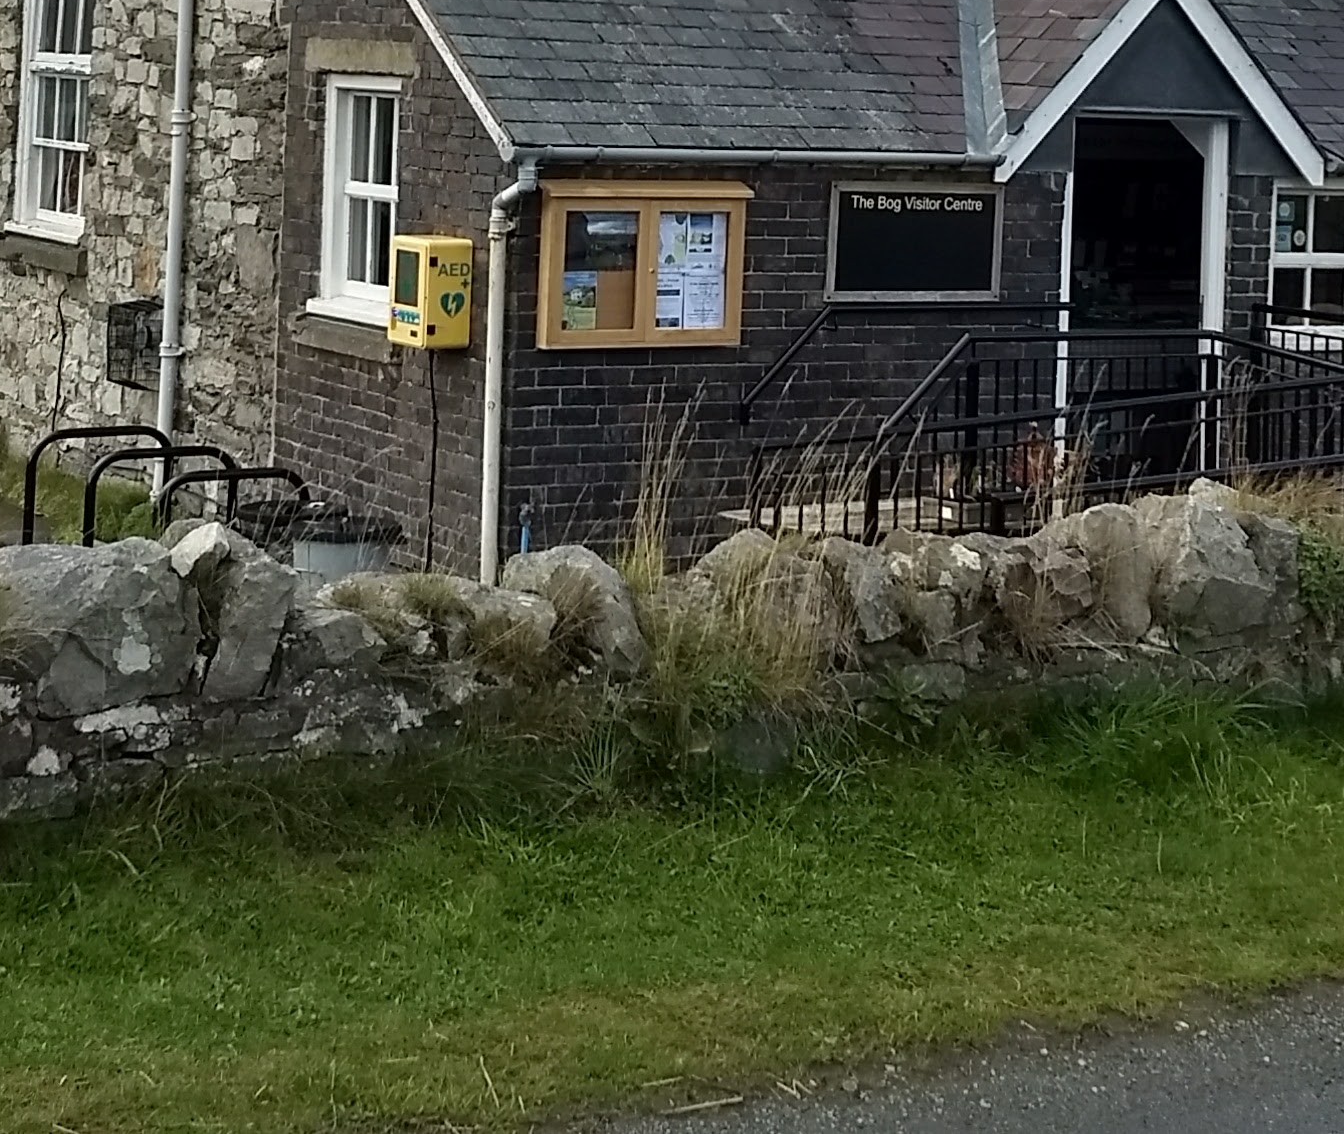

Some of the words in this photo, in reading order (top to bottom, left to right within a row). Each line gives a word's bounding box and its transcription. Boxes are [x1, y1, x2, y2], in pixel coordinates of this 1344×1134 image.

[851, 195, 874, 209] The
[877, 196, 901, 212] Bog
[904, 196, 941, 210] Visitor
[944, 197, 983, 211] Centre
[438, 263, 470, 277] AED
